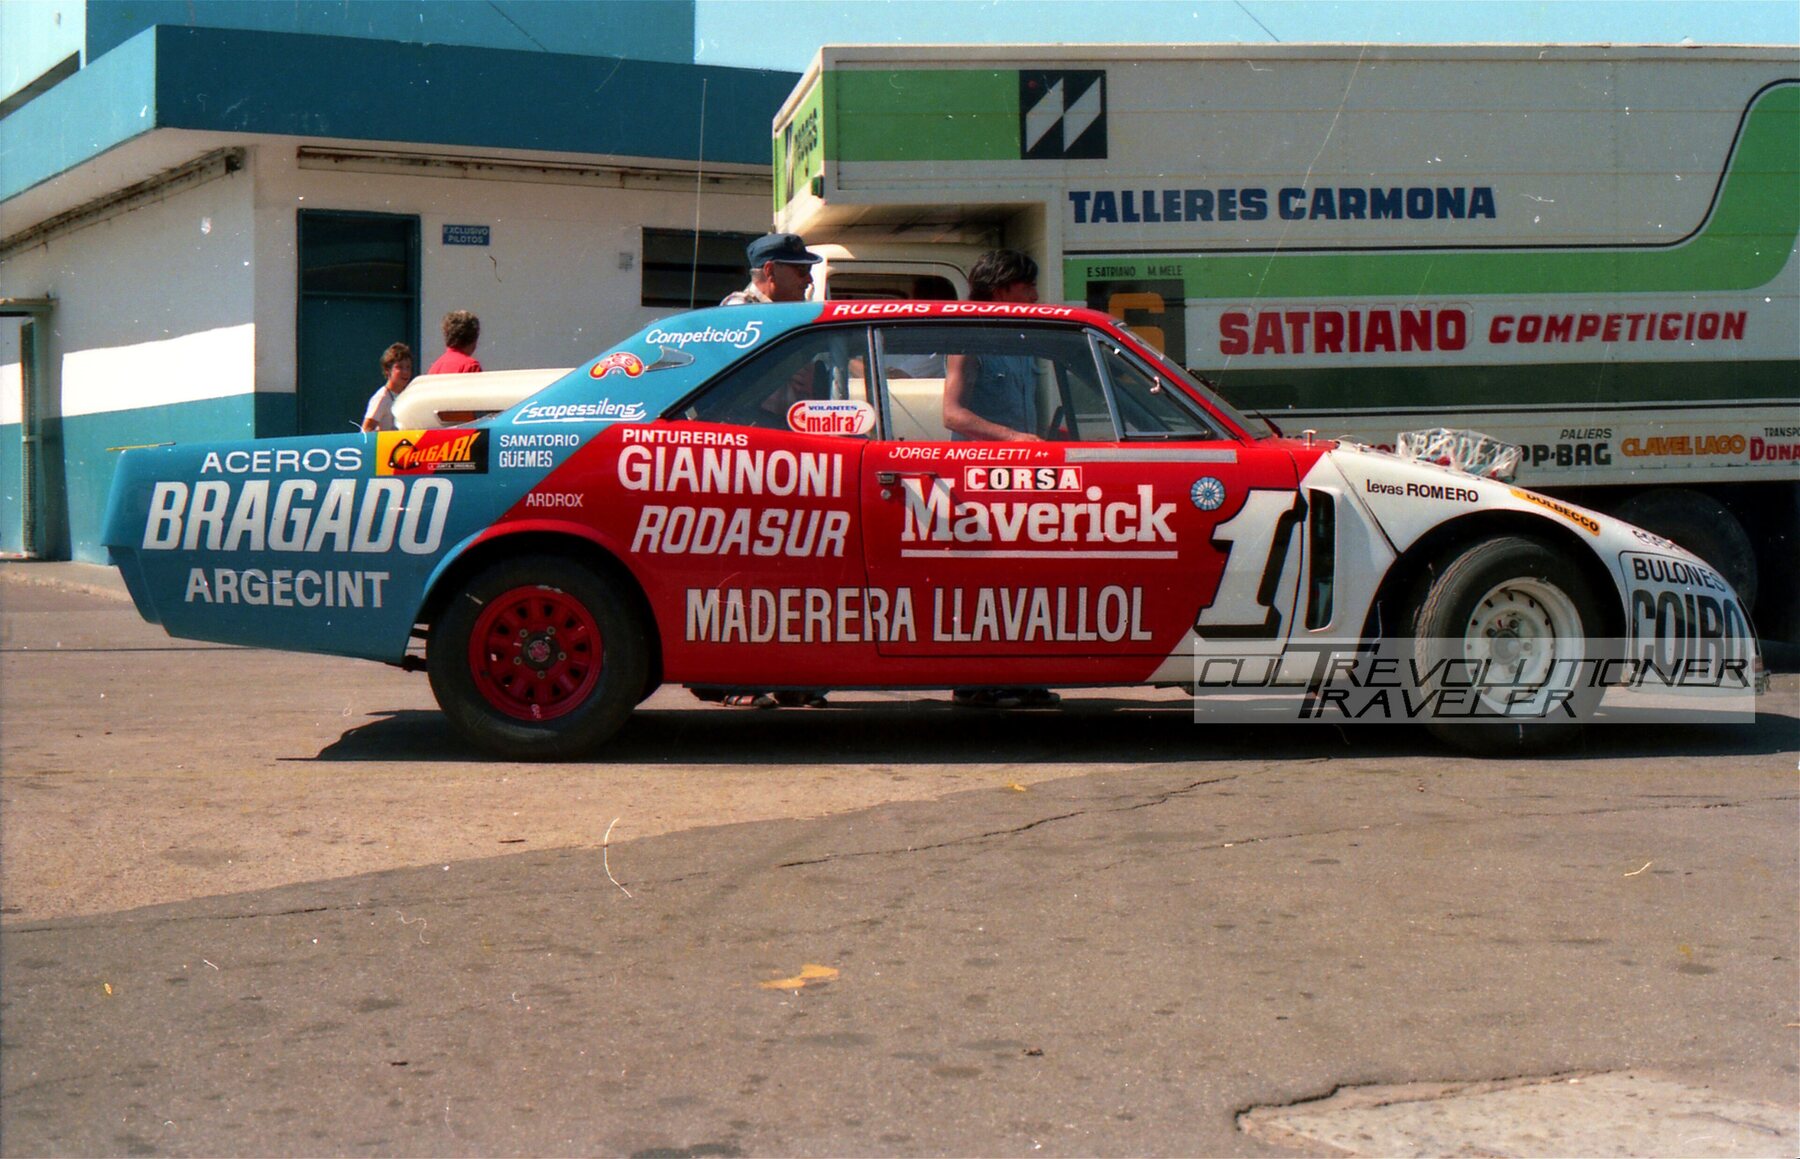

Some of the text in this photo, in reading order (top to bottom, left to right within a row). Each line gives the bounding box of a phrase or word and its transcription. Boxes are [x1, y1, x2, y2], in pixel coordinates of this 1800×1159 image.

[1069, 187, 1497, 223] TALLERES CARMONA
[444, 226, 488, 235] EXCLUSIVO
[448, 235, 483, 243] PILOTOS
[833, 304, 1073, 316] RUEDAS BOJANICH
[1219, 309, 1748, 355] SATRIANO COMPETICION
[500, 434, 580, 447] SANATORIO
[622, 429, 748, 446] PINTURERIAS
[1560, 428, 1612, 440] PALIERS
[200, 448, 363, 474] ACEROS
[499, 450, 553, 468] GÜEMES
[889, 447, 941, 459] JORGE
[944, 448, 1031, 460] ANGELETTI
[617, 445, 843, 497] GIANNONI
[966, 468, 1079, 490] CORSA
[526, 494, 584, 507] ARDROX
[1406, 483, 1479, 502] ROMERO
[142, 478, 454, 554] BRAGADO
[901, 477, 1177, 543] Maverick
[630, 505, 850, 557] RODASUR
[1193, 488, 1305, 640] 1
[1632, 557, 1726, 592] BULONES
[184, 568, 390, 608] ARGECINT
[685, 585, 1153, 643] MADERERA LLAVALLOL
